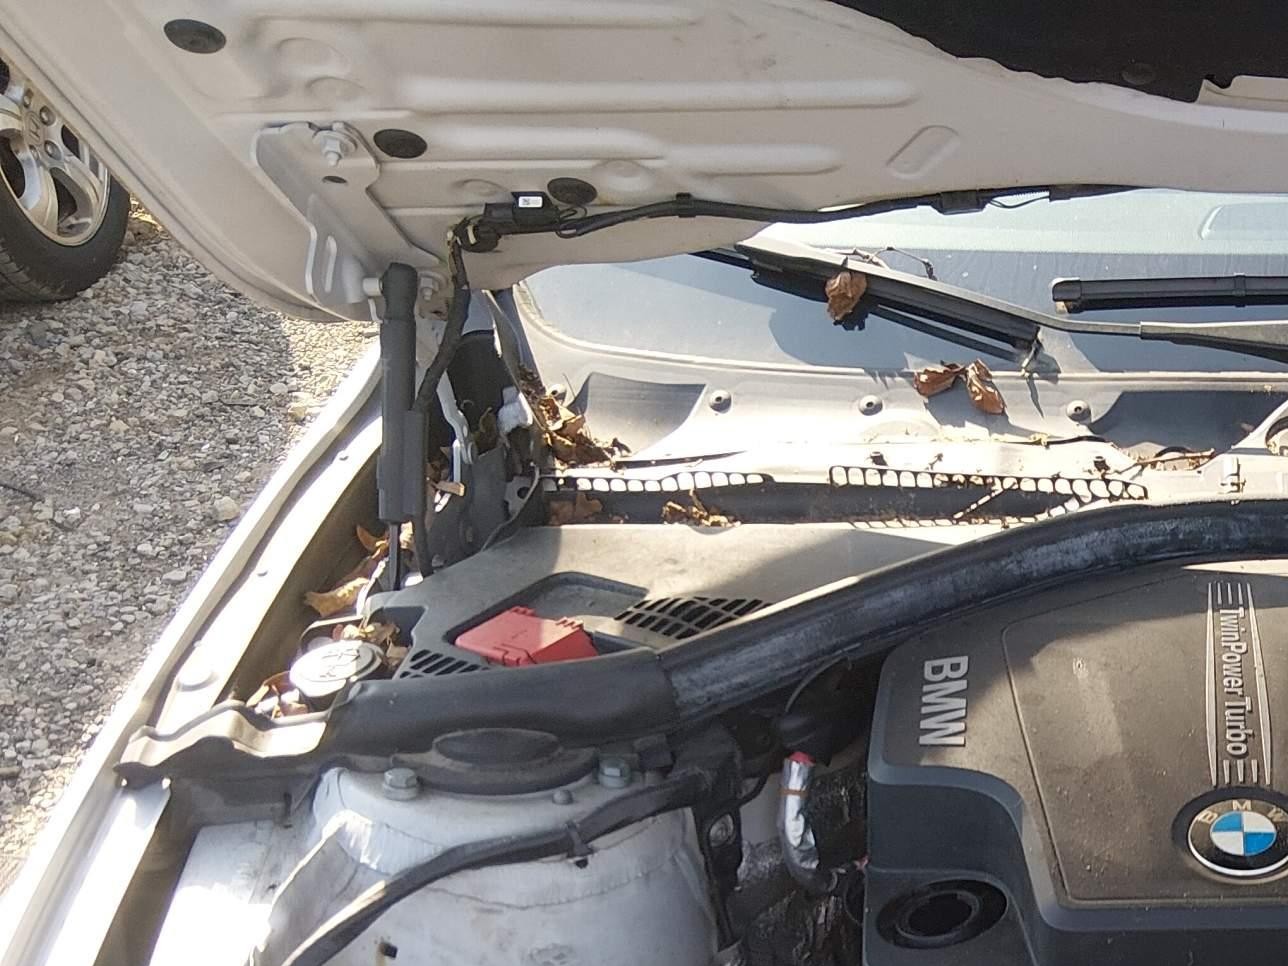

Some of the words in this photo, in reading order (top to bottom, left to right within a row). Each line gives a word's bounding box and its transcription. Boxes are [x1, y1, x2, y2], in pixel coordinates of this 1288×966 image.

[1219, 606, 1248, 697] TwinPower
[919, 655, 969, 746] BMW
[1224, 696, 1254, 757] Turbo
[1197, 799, 1288, 825] BMW
